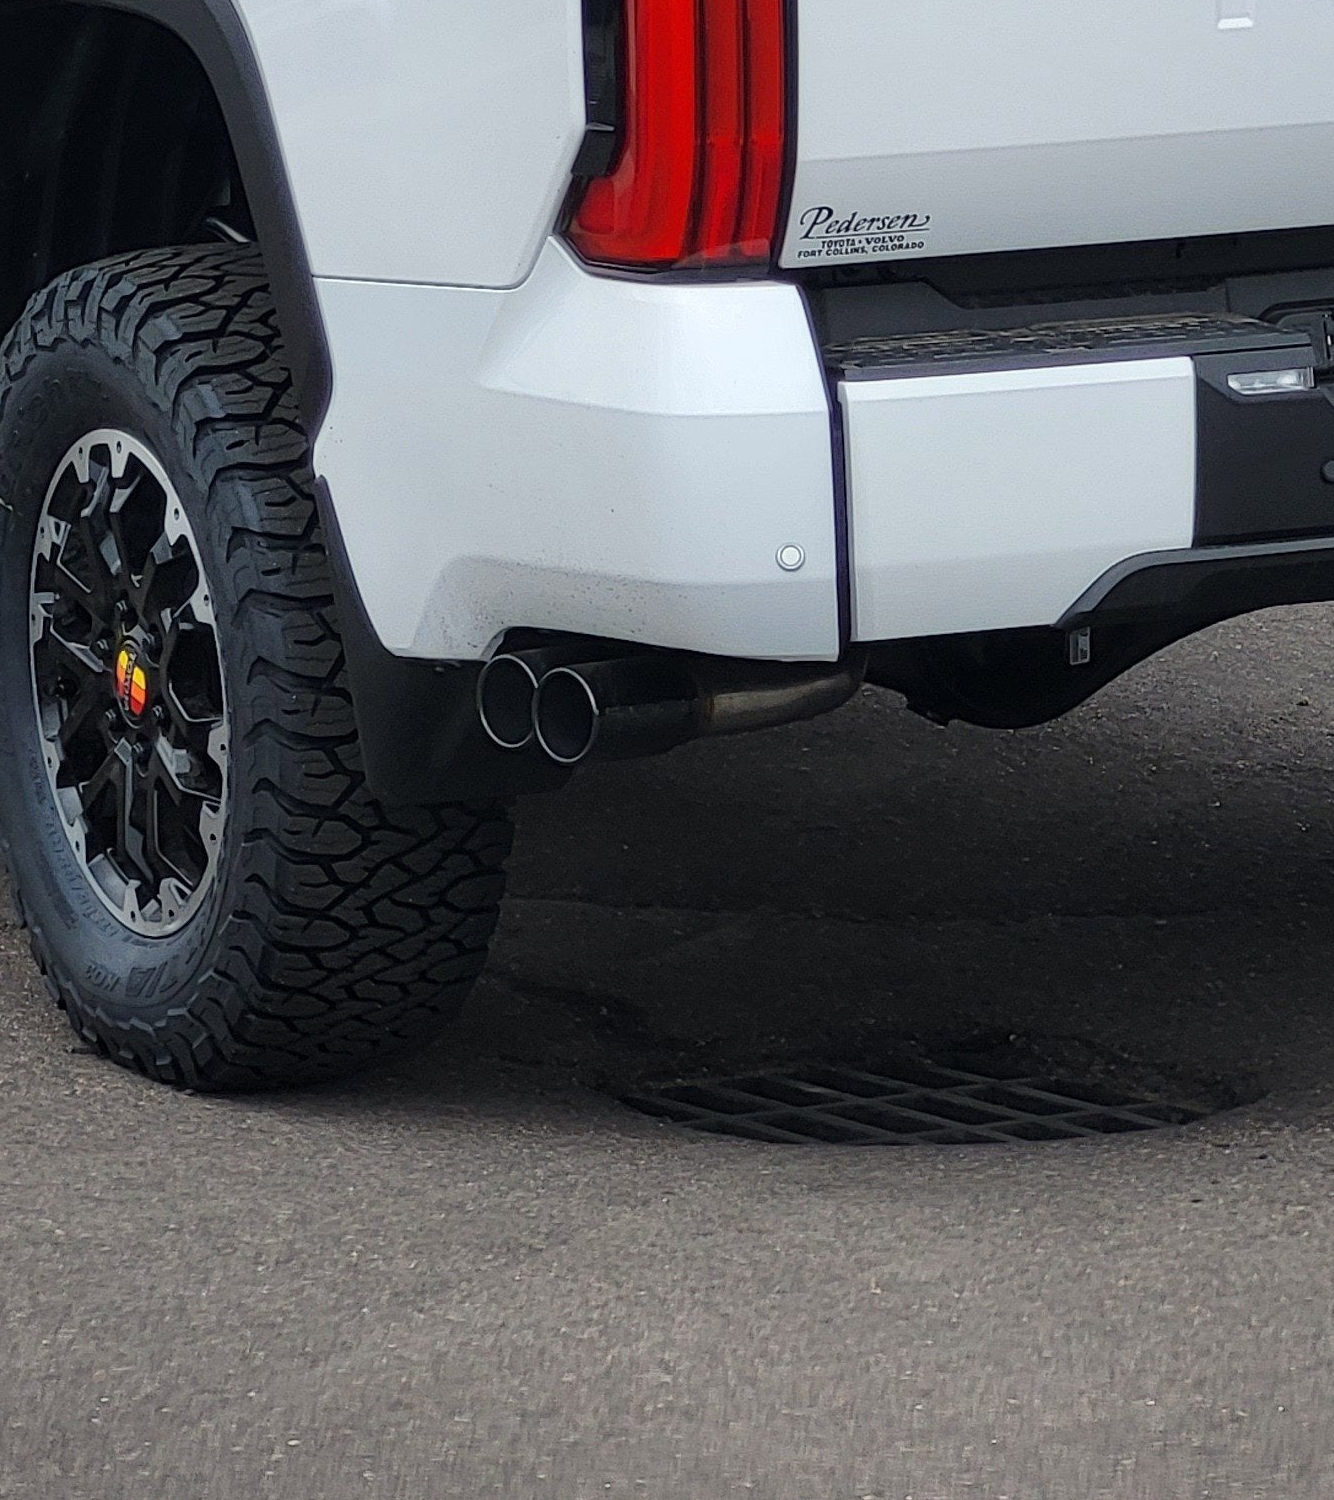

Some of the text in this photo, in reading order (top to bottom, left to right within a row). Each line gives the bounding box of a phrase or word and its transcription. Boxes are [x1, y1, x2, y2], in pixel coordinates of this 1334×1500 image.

[799, 206, 931, 240] Pedersen
[797, 249, 822, 259] FORT
[872, 240, 925, 253] COLORADO
[821, 234, 905, 249] TOYOTA VOLVO
